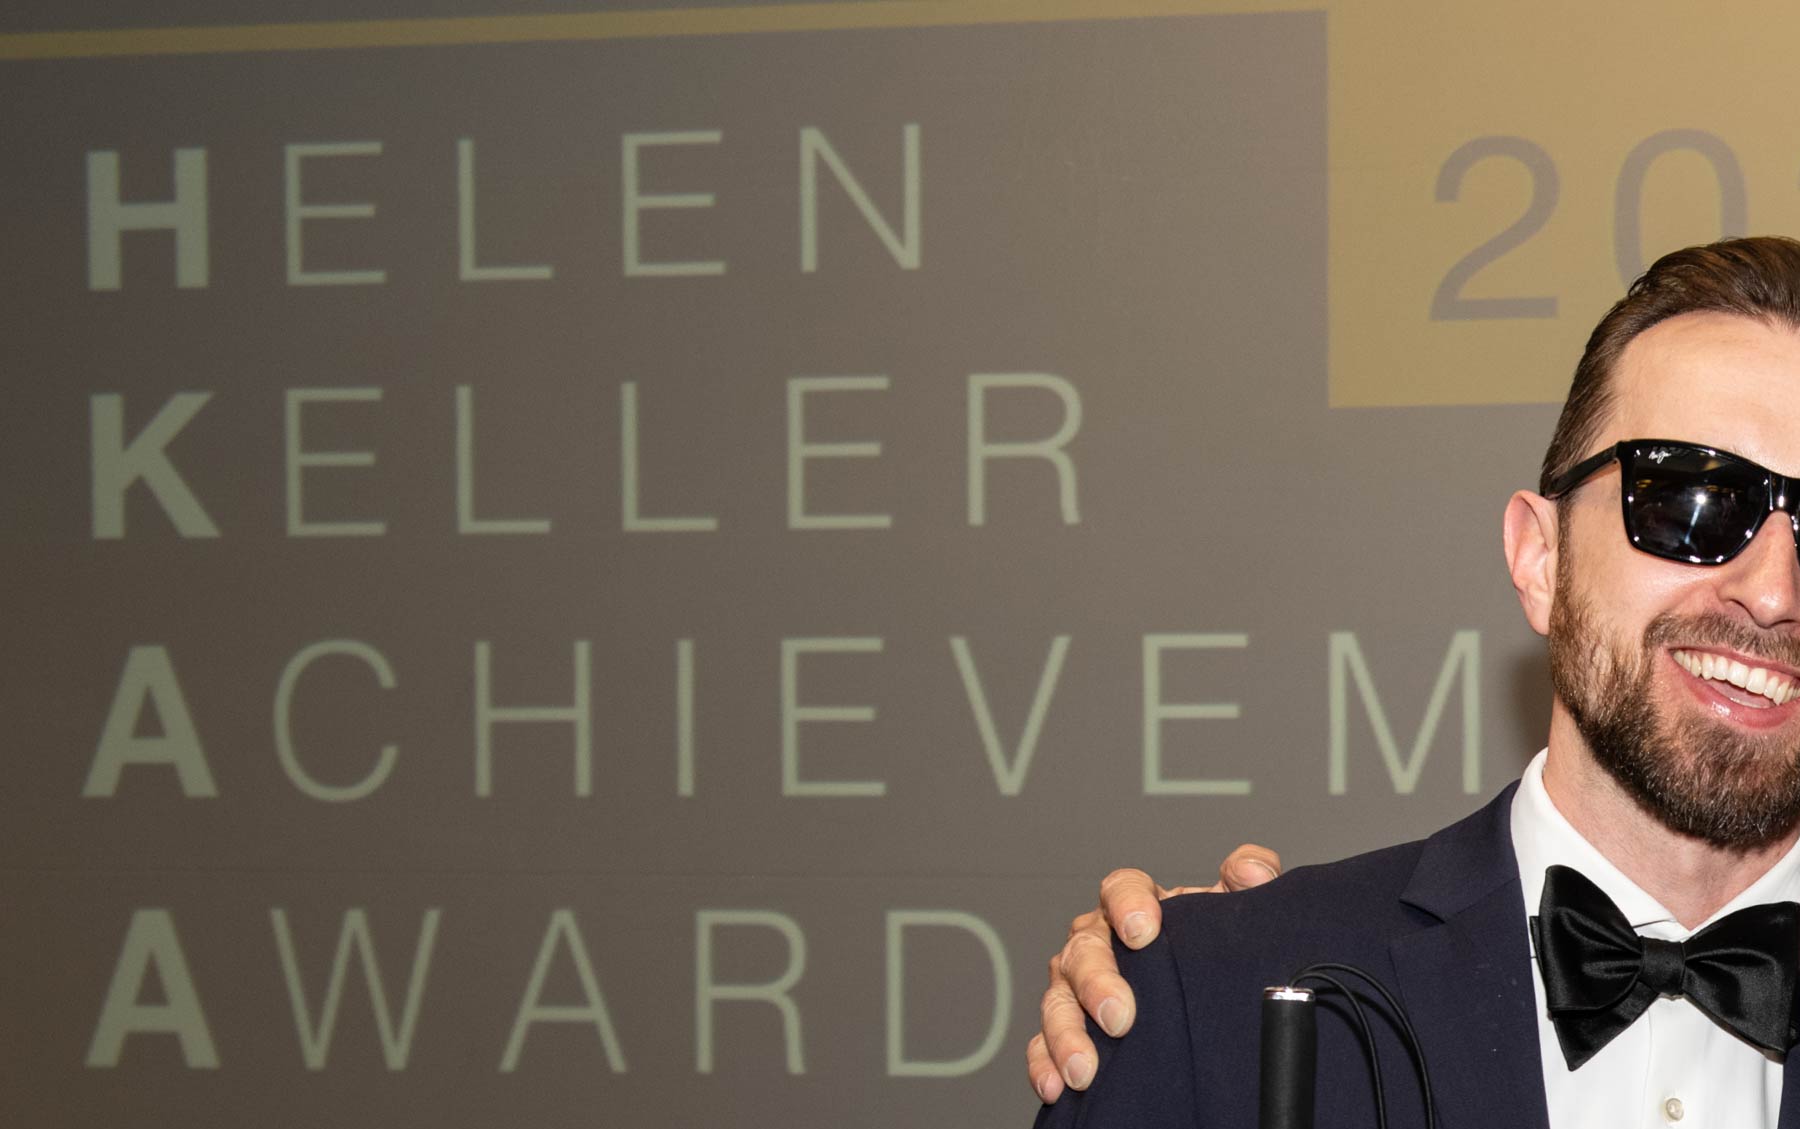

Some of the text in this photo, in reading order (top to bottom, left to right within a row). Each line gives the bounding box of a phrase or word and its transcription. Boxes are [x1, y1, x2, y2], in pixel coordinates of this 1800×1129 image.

[87, 123, 921, 291] HELEN
[90, 373, 1084, 540] KELLER
[84, 908, 1015, 1077] AWARD
